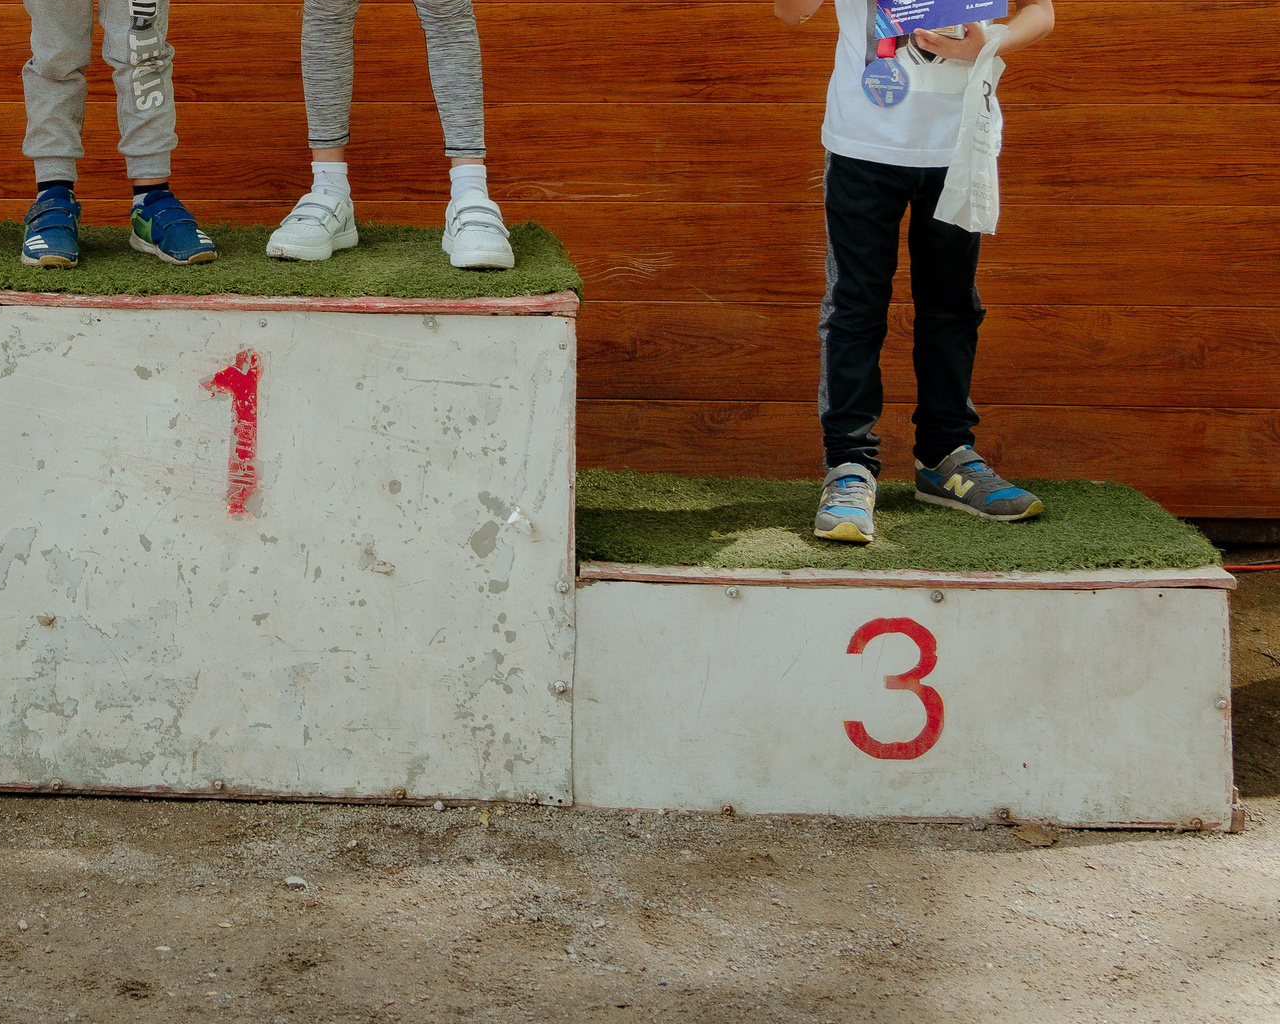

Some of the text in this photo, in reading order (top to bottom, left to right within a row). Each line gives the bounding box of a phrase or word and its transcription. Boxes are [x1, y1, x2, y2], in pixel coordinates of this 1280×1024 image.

[891, 68, 899, 82] 3
[199, 346, 261, 520] 1
[942, 473, 976, 498] N
[842, 616, 945, 760] 3
